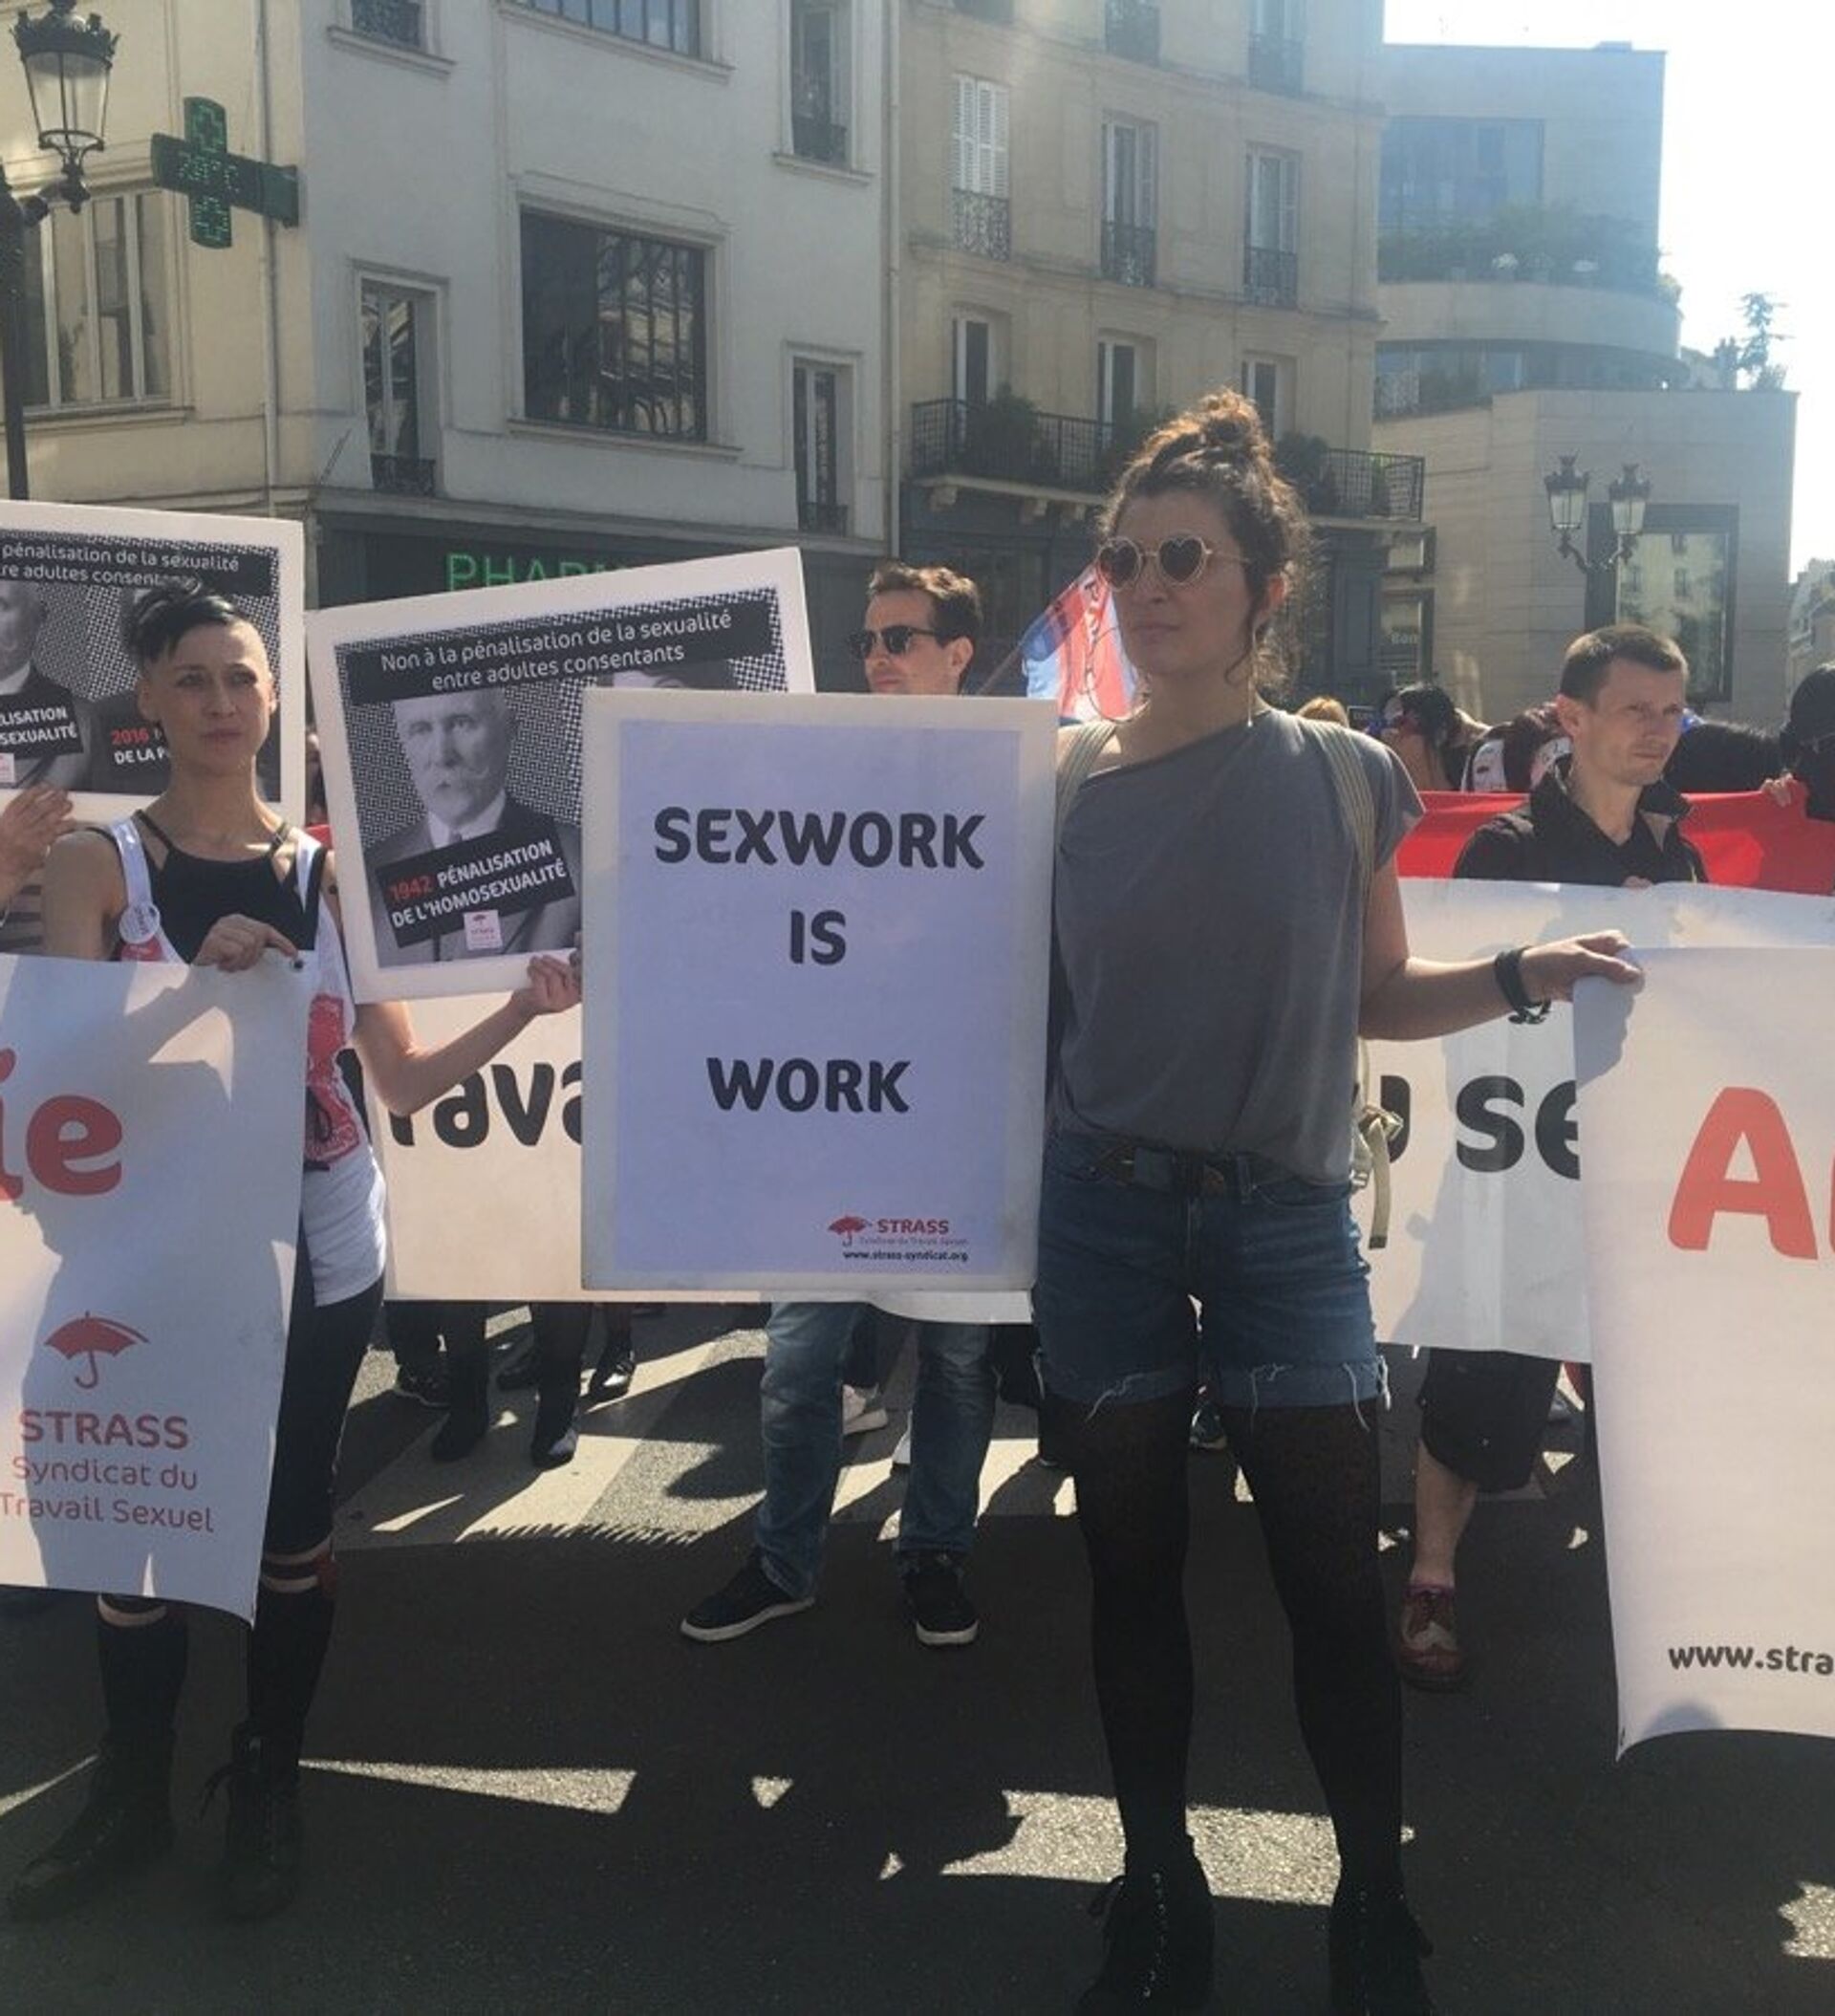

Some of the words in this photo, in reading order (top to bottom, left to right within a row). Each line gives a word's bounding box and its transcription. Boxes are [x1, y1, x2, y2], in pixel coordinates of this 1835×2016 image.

[2, 542, 112, 562] pénalisation
[117, 550, 138, 564] de
[140, 551, 158, 566] la
[161, 554, 239, 572] sexualité
[23, 564, 89, 581] adultes
[381, 653, 421, 672] Non
[424, 647, 436, 667] à
[439, 646, 458, 664] la
[462, 631, 584, 664] pénalisation
[587, 626, 613, 645] de
[617, 623, 636, 641] la
[640, 608, 732, 639] sexualité
[432, 670, 482, 691] entre
[486, 661, 559, 683] adultes
[563, 644, 684, 673] consentants
[110, 727, 150, 746] 2016
[114, 749, 136, 766] DE
[137, 748, 156, 762] LA
[653, 806, 986, 870] SEXWORK
[388, 876, 433, 901] 1942
[436, 839, 553, 888] PÉNALISATION
[392, 909, 416, 929] DE
[416, 858, 567, 920] L'HOMOSEXUALITÉ
[788, 910, 847, 966] IS
[706, 1056, 911, 1114] WORK
[877, 1219, 950, 1235] STRASS
[19, 1410, 189, 1450] STRASS
[12, 1456, 152, 1486] Syndicat
[160, 1463, 198, 1491] du
[0, 1492, 105, 1523] Travail
[113, 1498, 214, 1533] Sexuel
